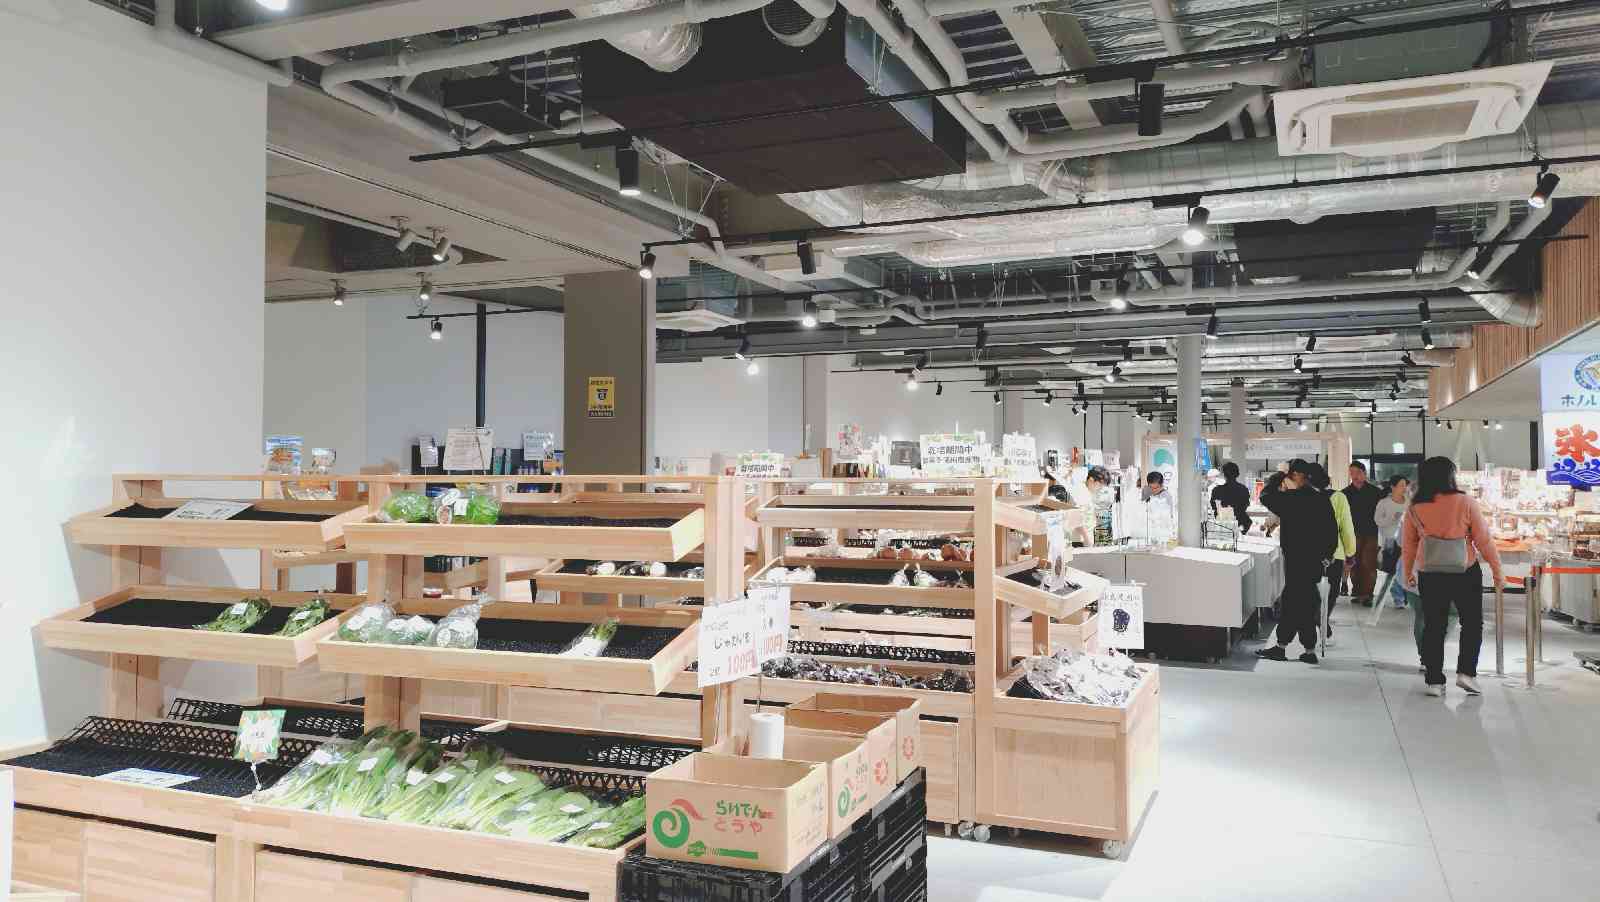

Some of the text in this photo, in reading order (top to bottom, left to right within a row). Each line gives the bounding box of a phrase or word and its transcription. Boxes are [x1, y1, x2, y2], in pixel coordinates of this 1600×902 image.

[1554, 424, 1600, 463] 氷
[714, 818, 763, 835] とうや
